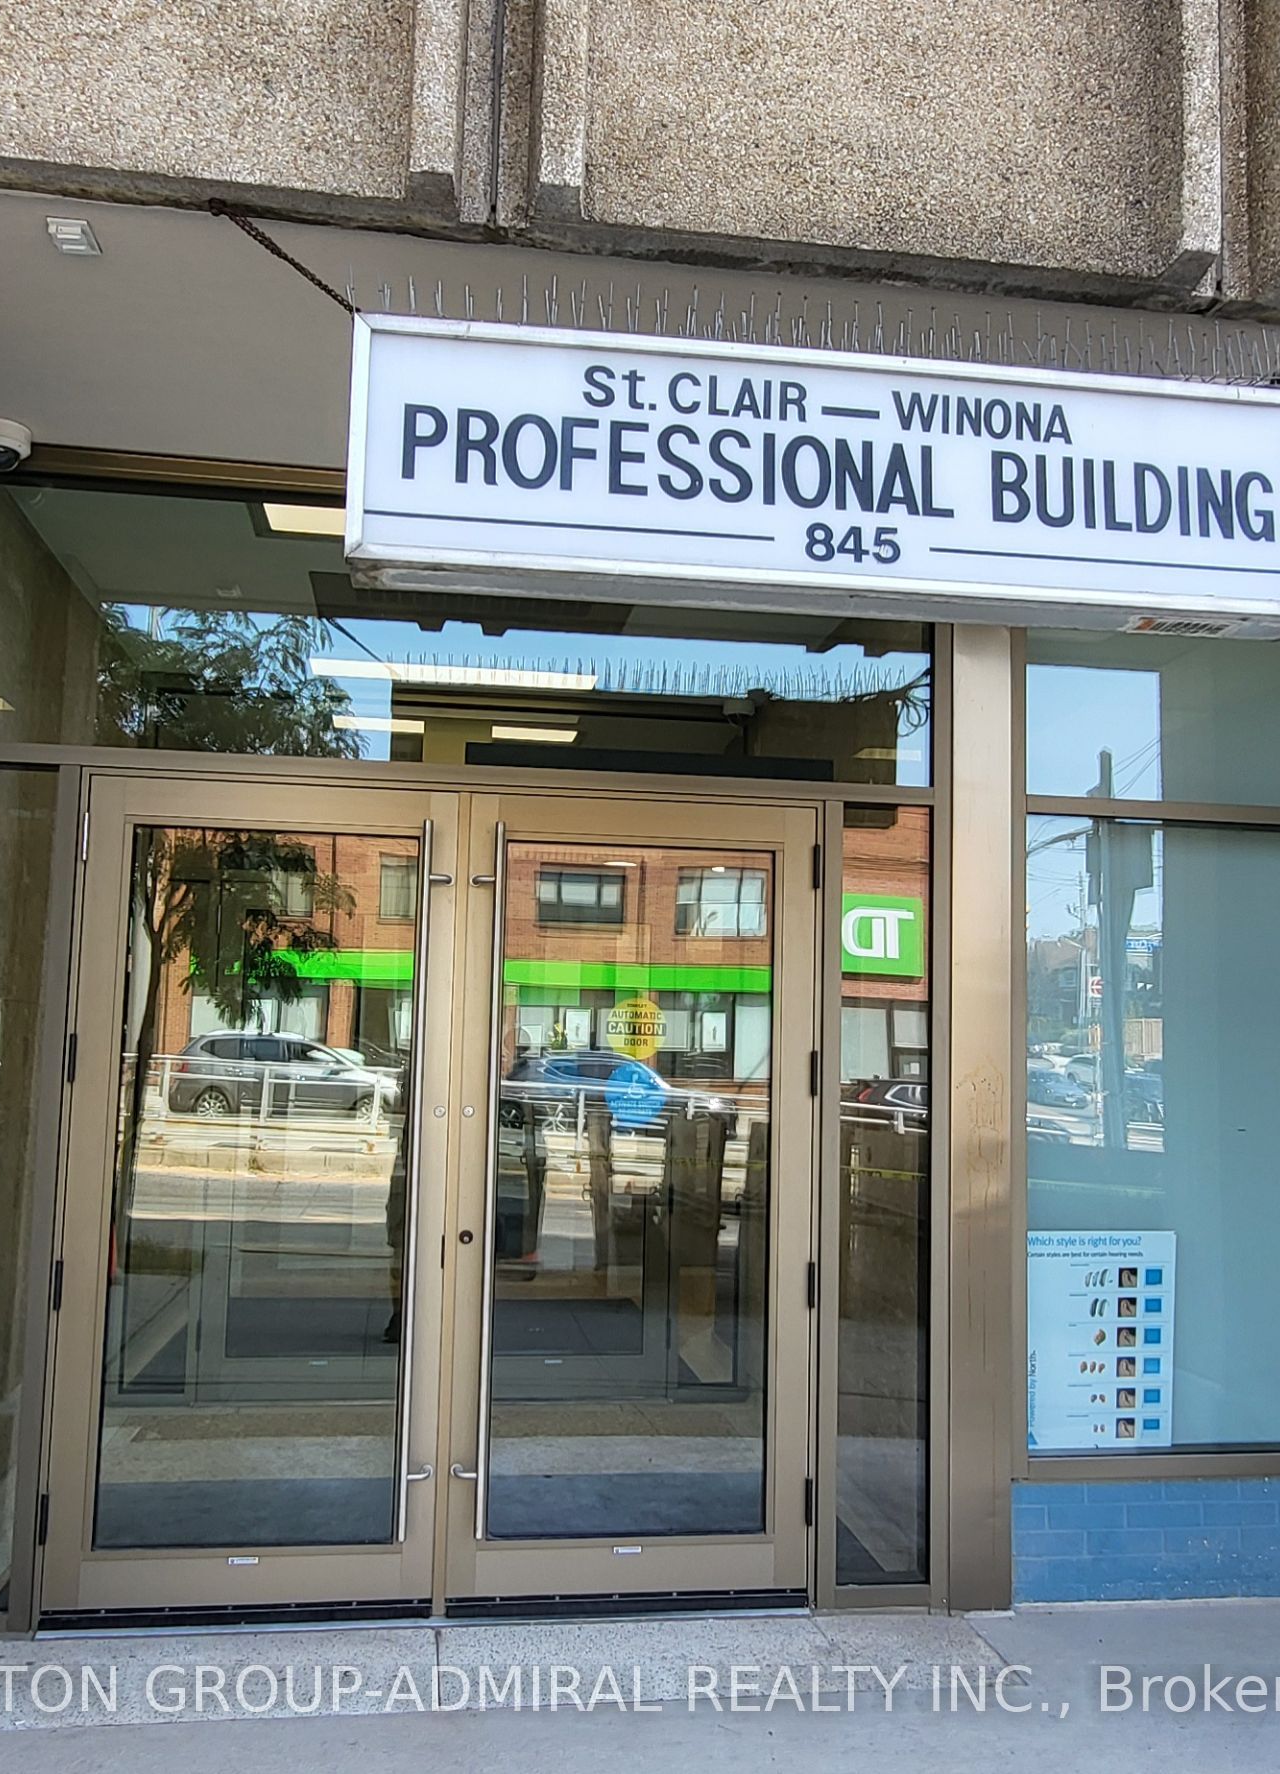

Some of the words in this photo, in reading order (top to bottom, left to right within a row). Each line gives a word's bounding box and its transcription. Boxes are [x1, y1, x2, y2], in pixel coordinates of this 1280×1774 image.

[891, 390, 1072, 445] WINONA
[401, 402, 955, 518] PROFESSIONAL
[991, 450, 1276, 543] BUILDING
[805, 522, 901, 563] 845
[611, 1010, 662, 1020] AUTOMATIC
[608, 1022, 663, 1035] CAUTION
[624, 1038, 648, 1047] DOOR
[1028, 1236, 1054, 1246] Which
[1056, 1236, 1077, 1248] style
[1079, 1236, 1086, 1246] is
[1088, 1236, 1108, 1248] right
[1109, 1236, 1121, 1246] for
[1122, 1236, 1142, 1248] you?
